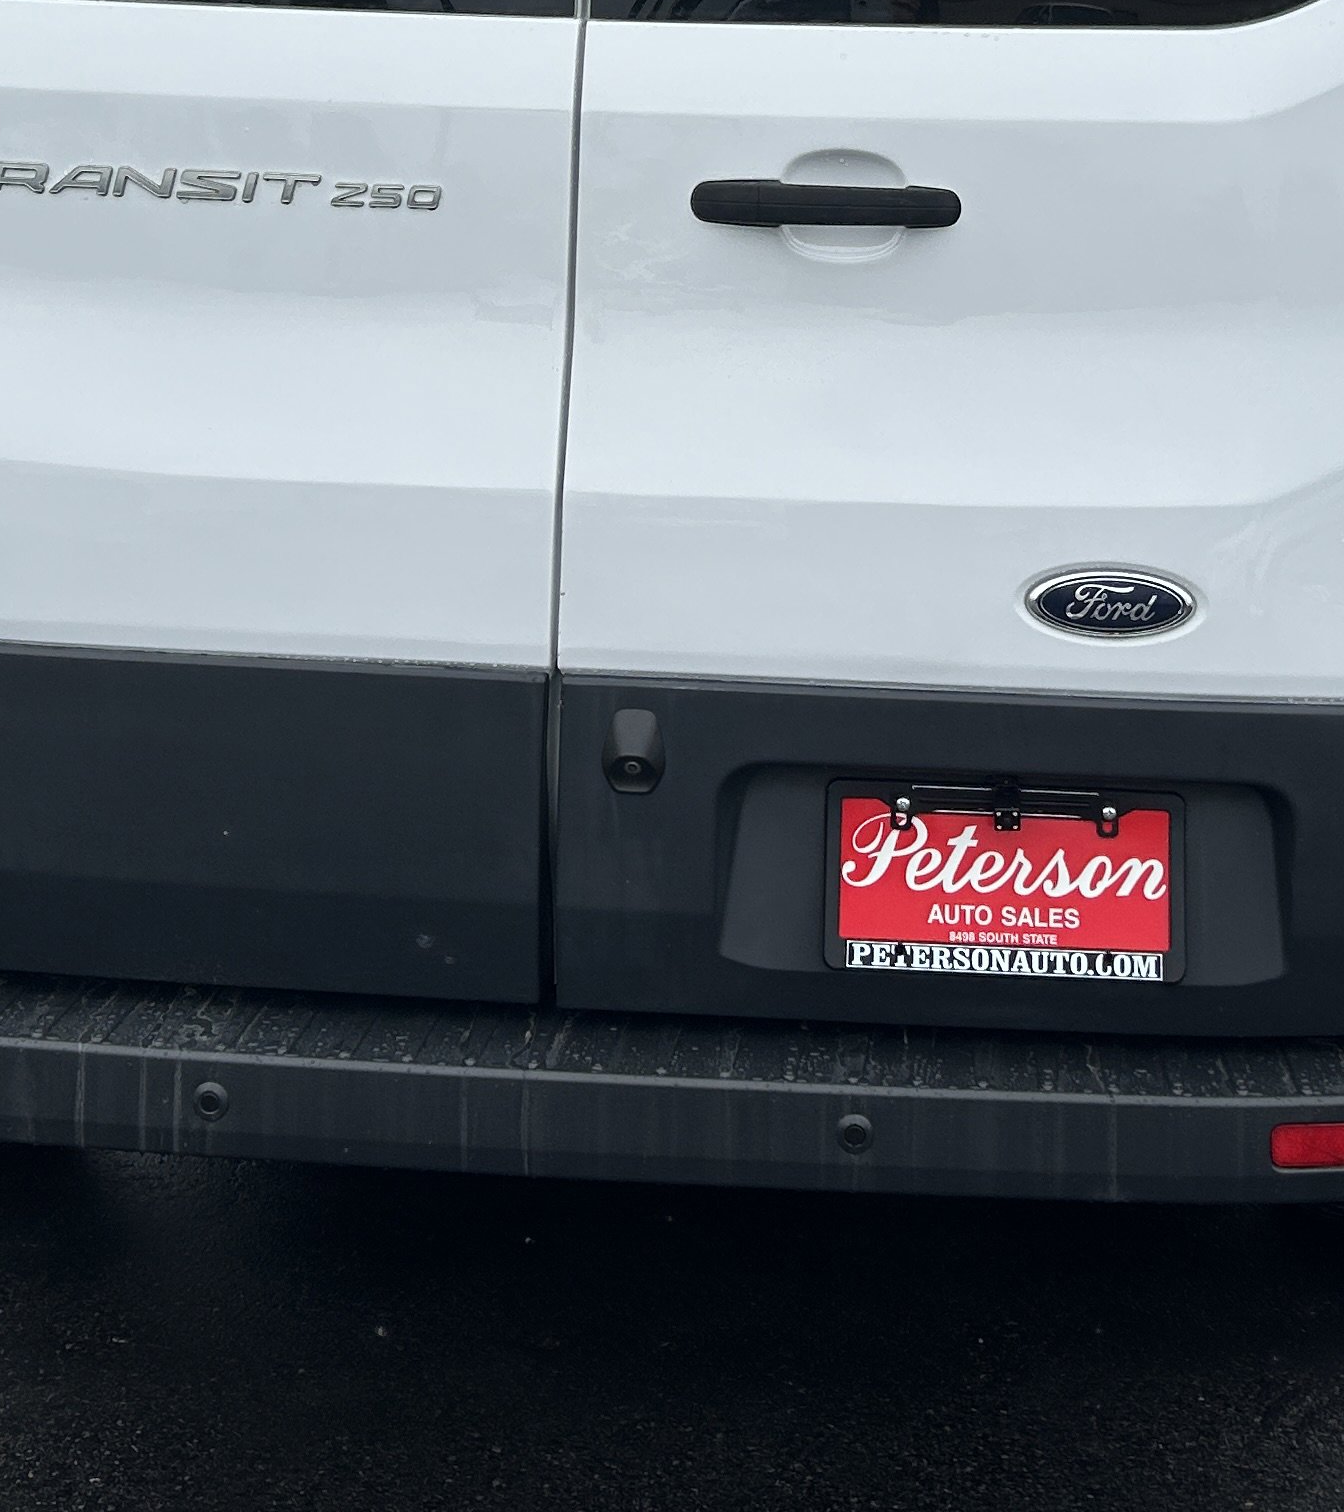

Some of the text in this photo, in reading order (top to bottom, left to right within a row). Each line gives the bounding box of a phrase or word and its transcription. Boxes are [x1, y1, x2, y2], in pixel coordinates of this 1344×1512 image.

[330, 182, 442, 210] 250
[1065, 583, 1158, 622] Ford
[842, 812, 1167, 900] Peterson
[927, 903, 1080, 929] AUTO SALES
[949, 931, 1058, 945] 8498 SOUTH STATE
[851, 943, 1158, 978] PETERSONAUTO.COM
